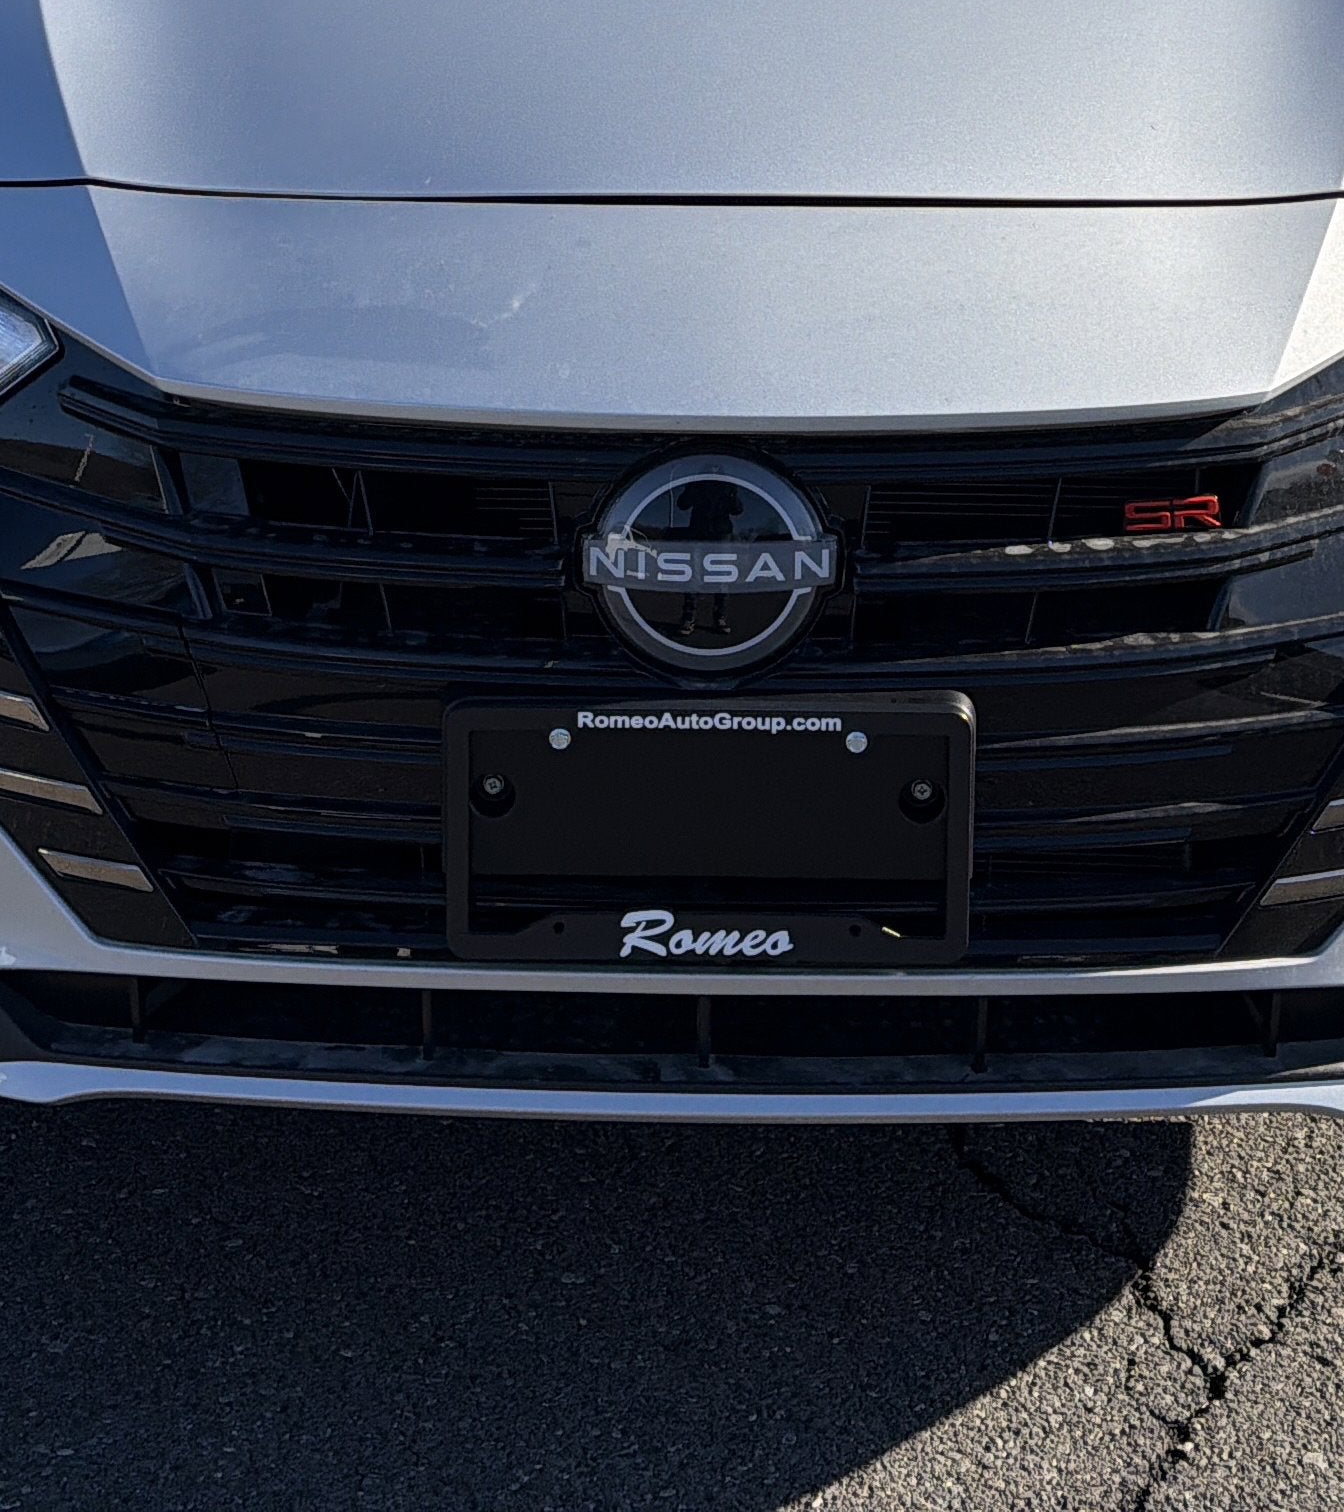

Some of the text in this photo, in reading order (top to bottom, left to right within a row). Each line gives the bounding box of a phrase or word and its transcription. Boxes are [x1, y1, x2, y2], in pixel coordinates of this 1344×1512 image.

[1124, 495, 1221, 530] SR
[589, 546, 830, 583] NISSAN
[576, 711, 842, 734] RomeoAutoGroup.com
[619, 909, 794, 958] Romeo
